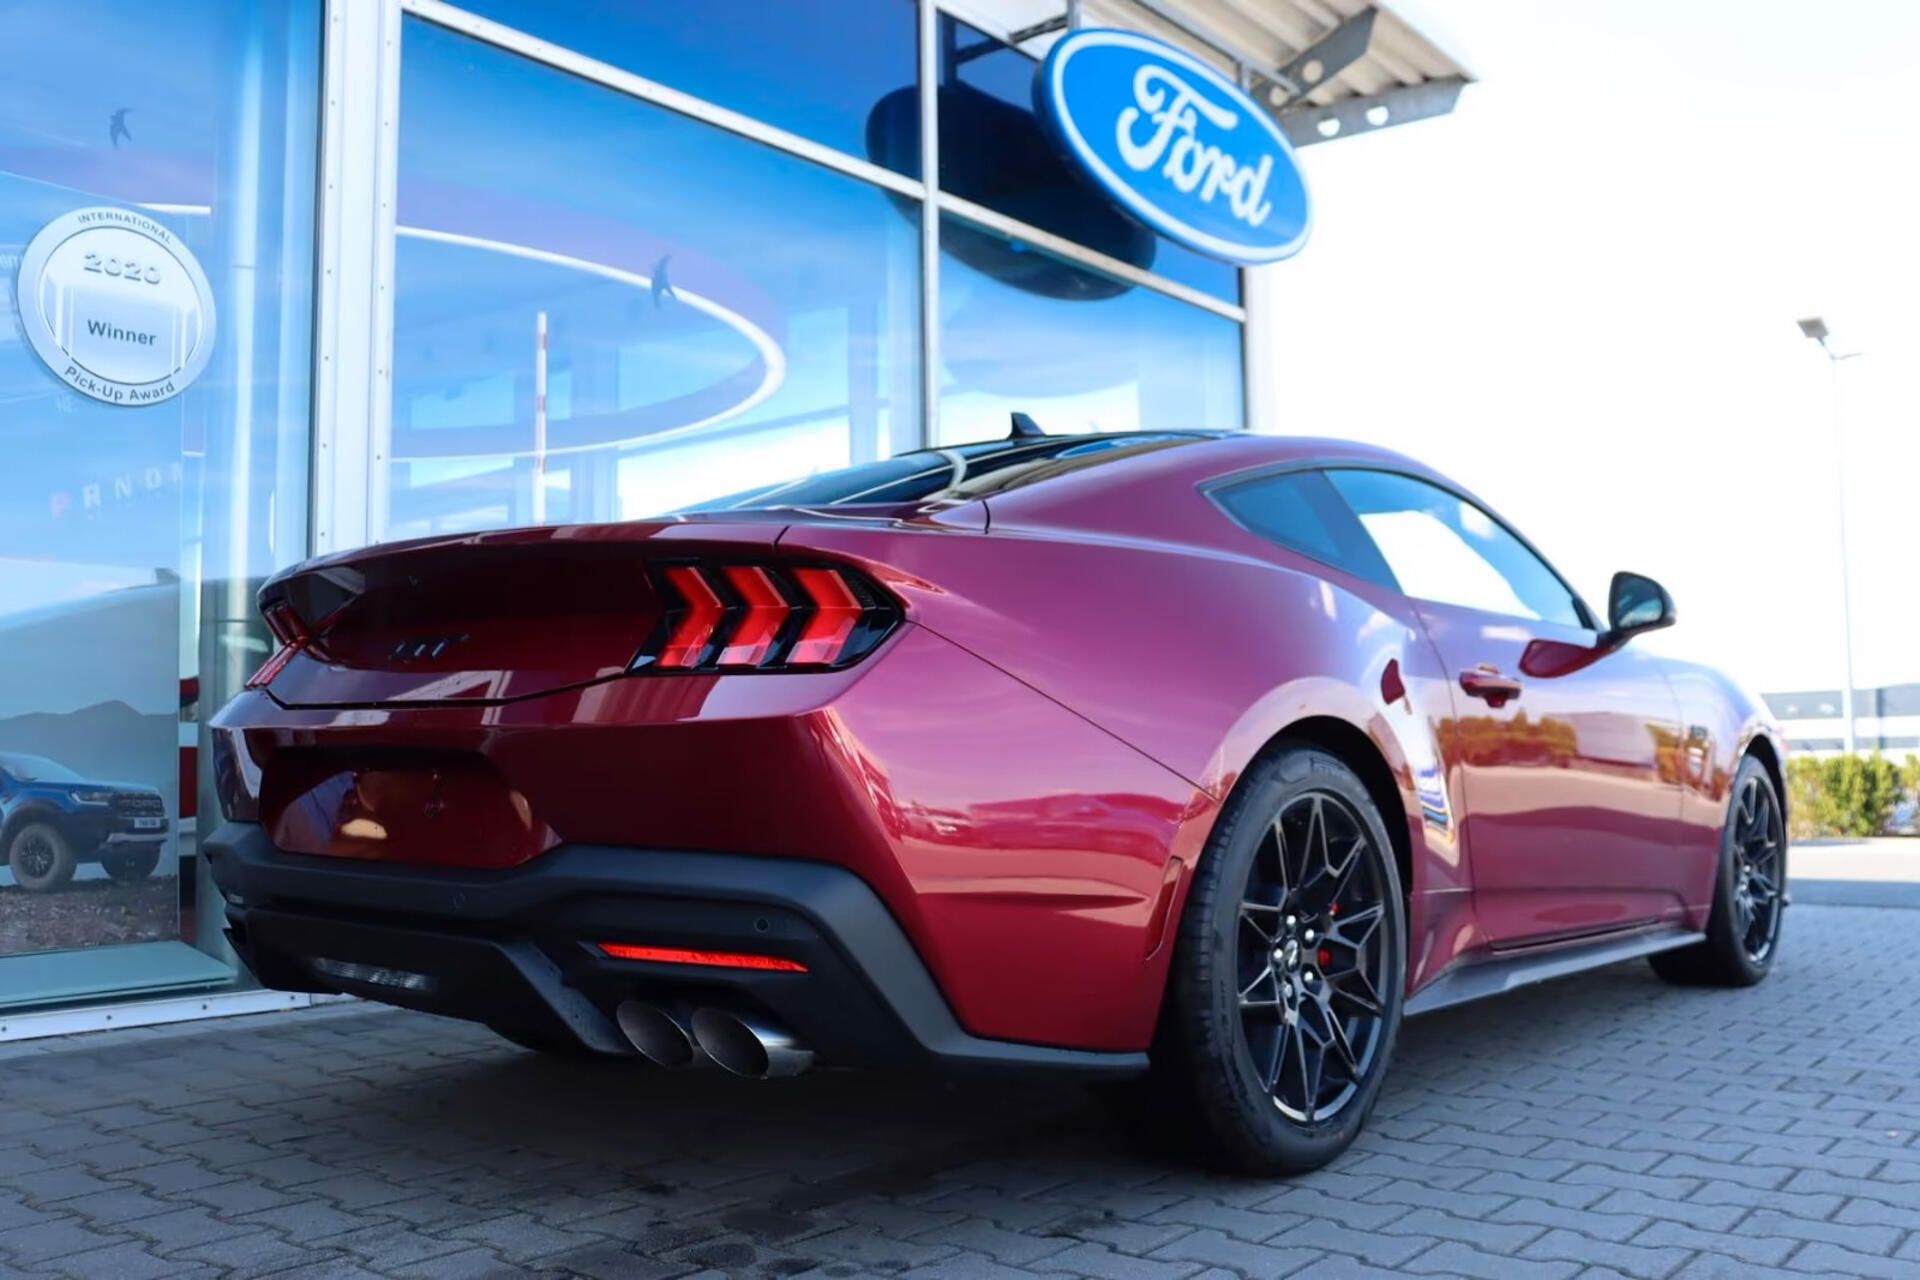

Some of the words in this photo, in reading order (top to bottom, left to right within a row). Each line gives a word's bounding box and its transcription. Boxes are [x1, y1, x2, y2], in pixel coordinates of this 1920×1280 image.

[1116, 63, 1273, 226] Ford
[78, 211, 170, 244] INTERNATIONAL
[83, 253, 161, 285] 2020
[87, 319, 156, 346] Winner
[64, 365, 124, 401] Pick-Up
[129, 380, 175, 401] Award
